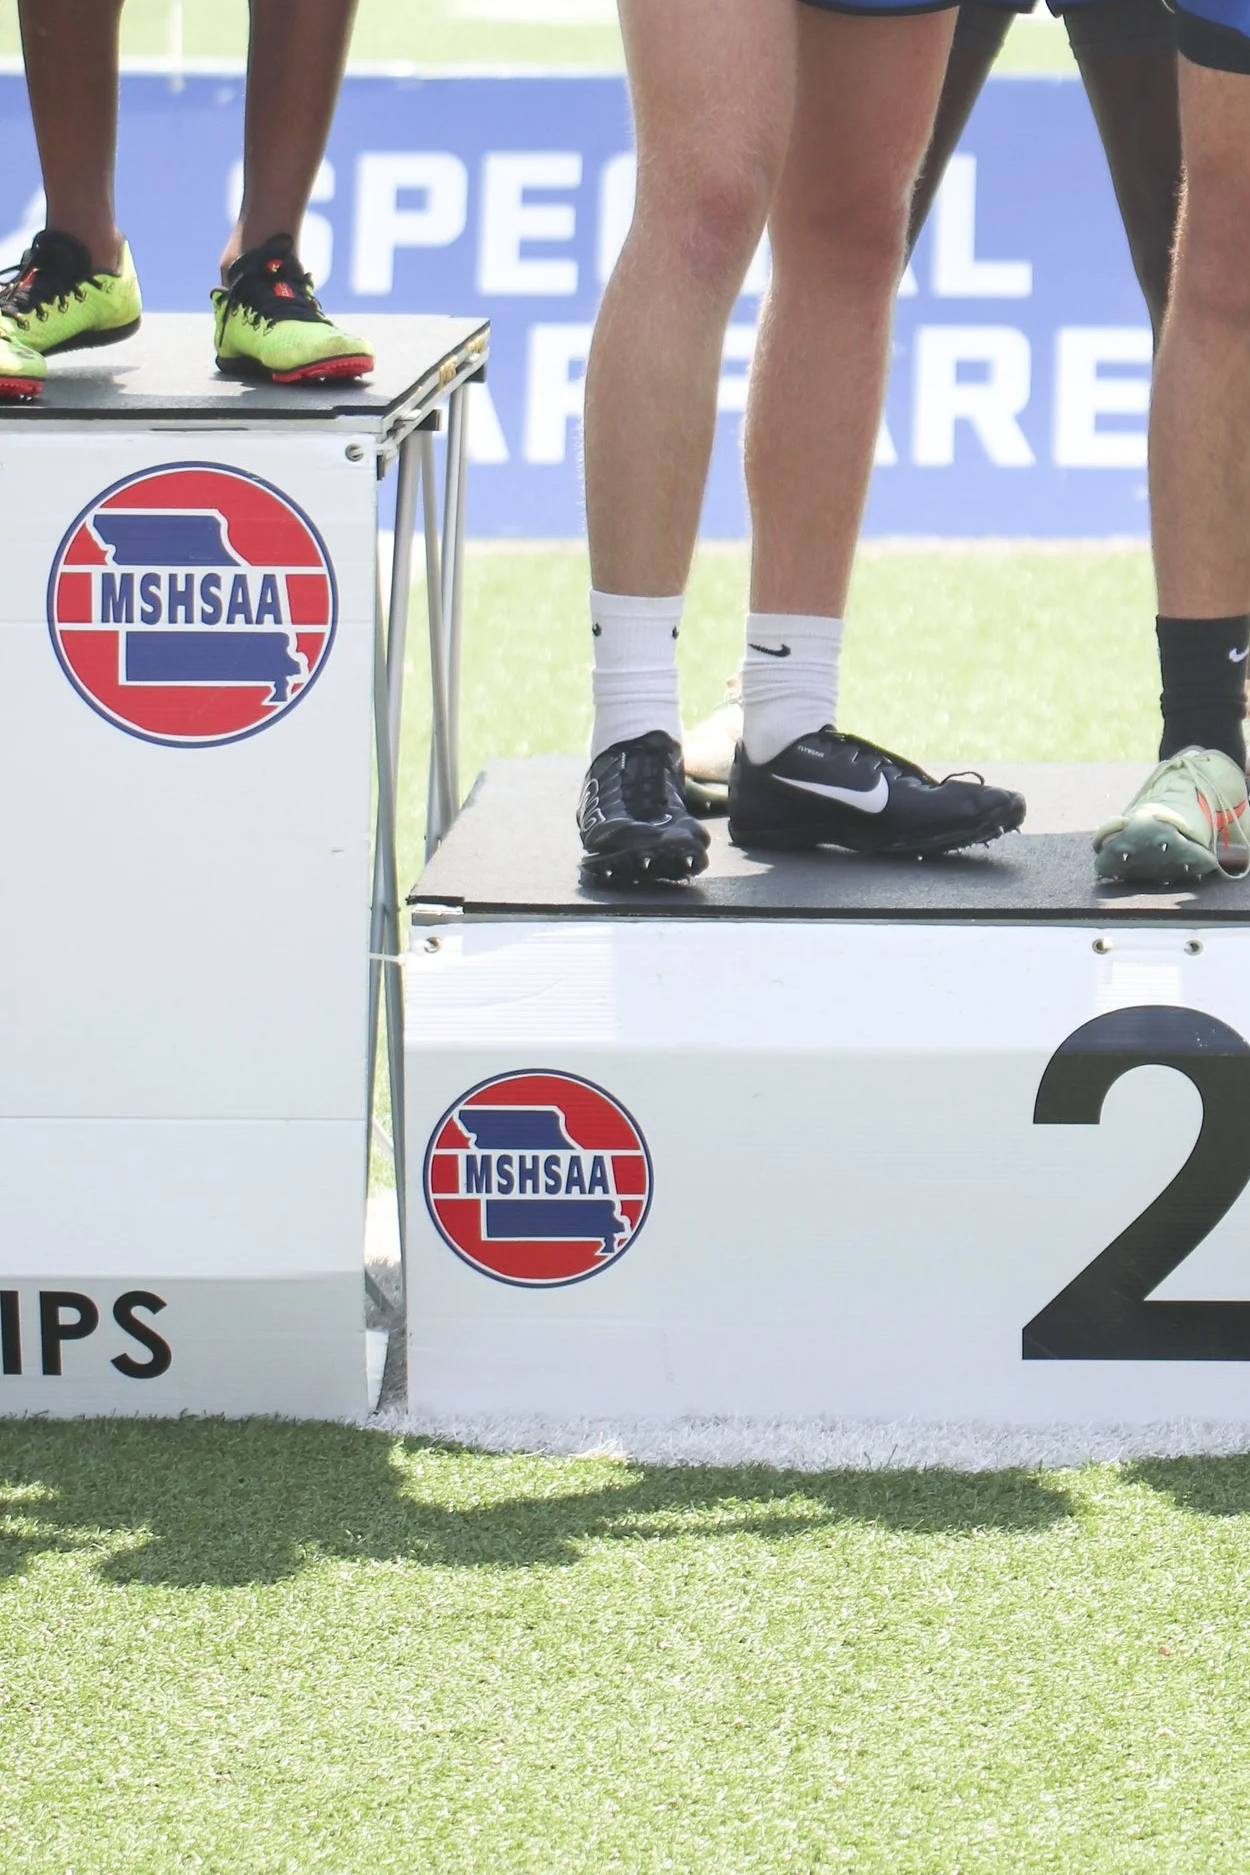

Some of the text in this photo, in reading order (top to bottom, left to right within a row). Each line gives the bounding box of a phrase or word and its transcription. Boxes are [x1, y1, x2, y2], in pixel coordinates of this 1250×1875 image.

[99, 571, 283, 629] MSHSAA
[463, 1151, 611, 1197] MSHSAA
[0, 1290, 173, 1381] IPS
